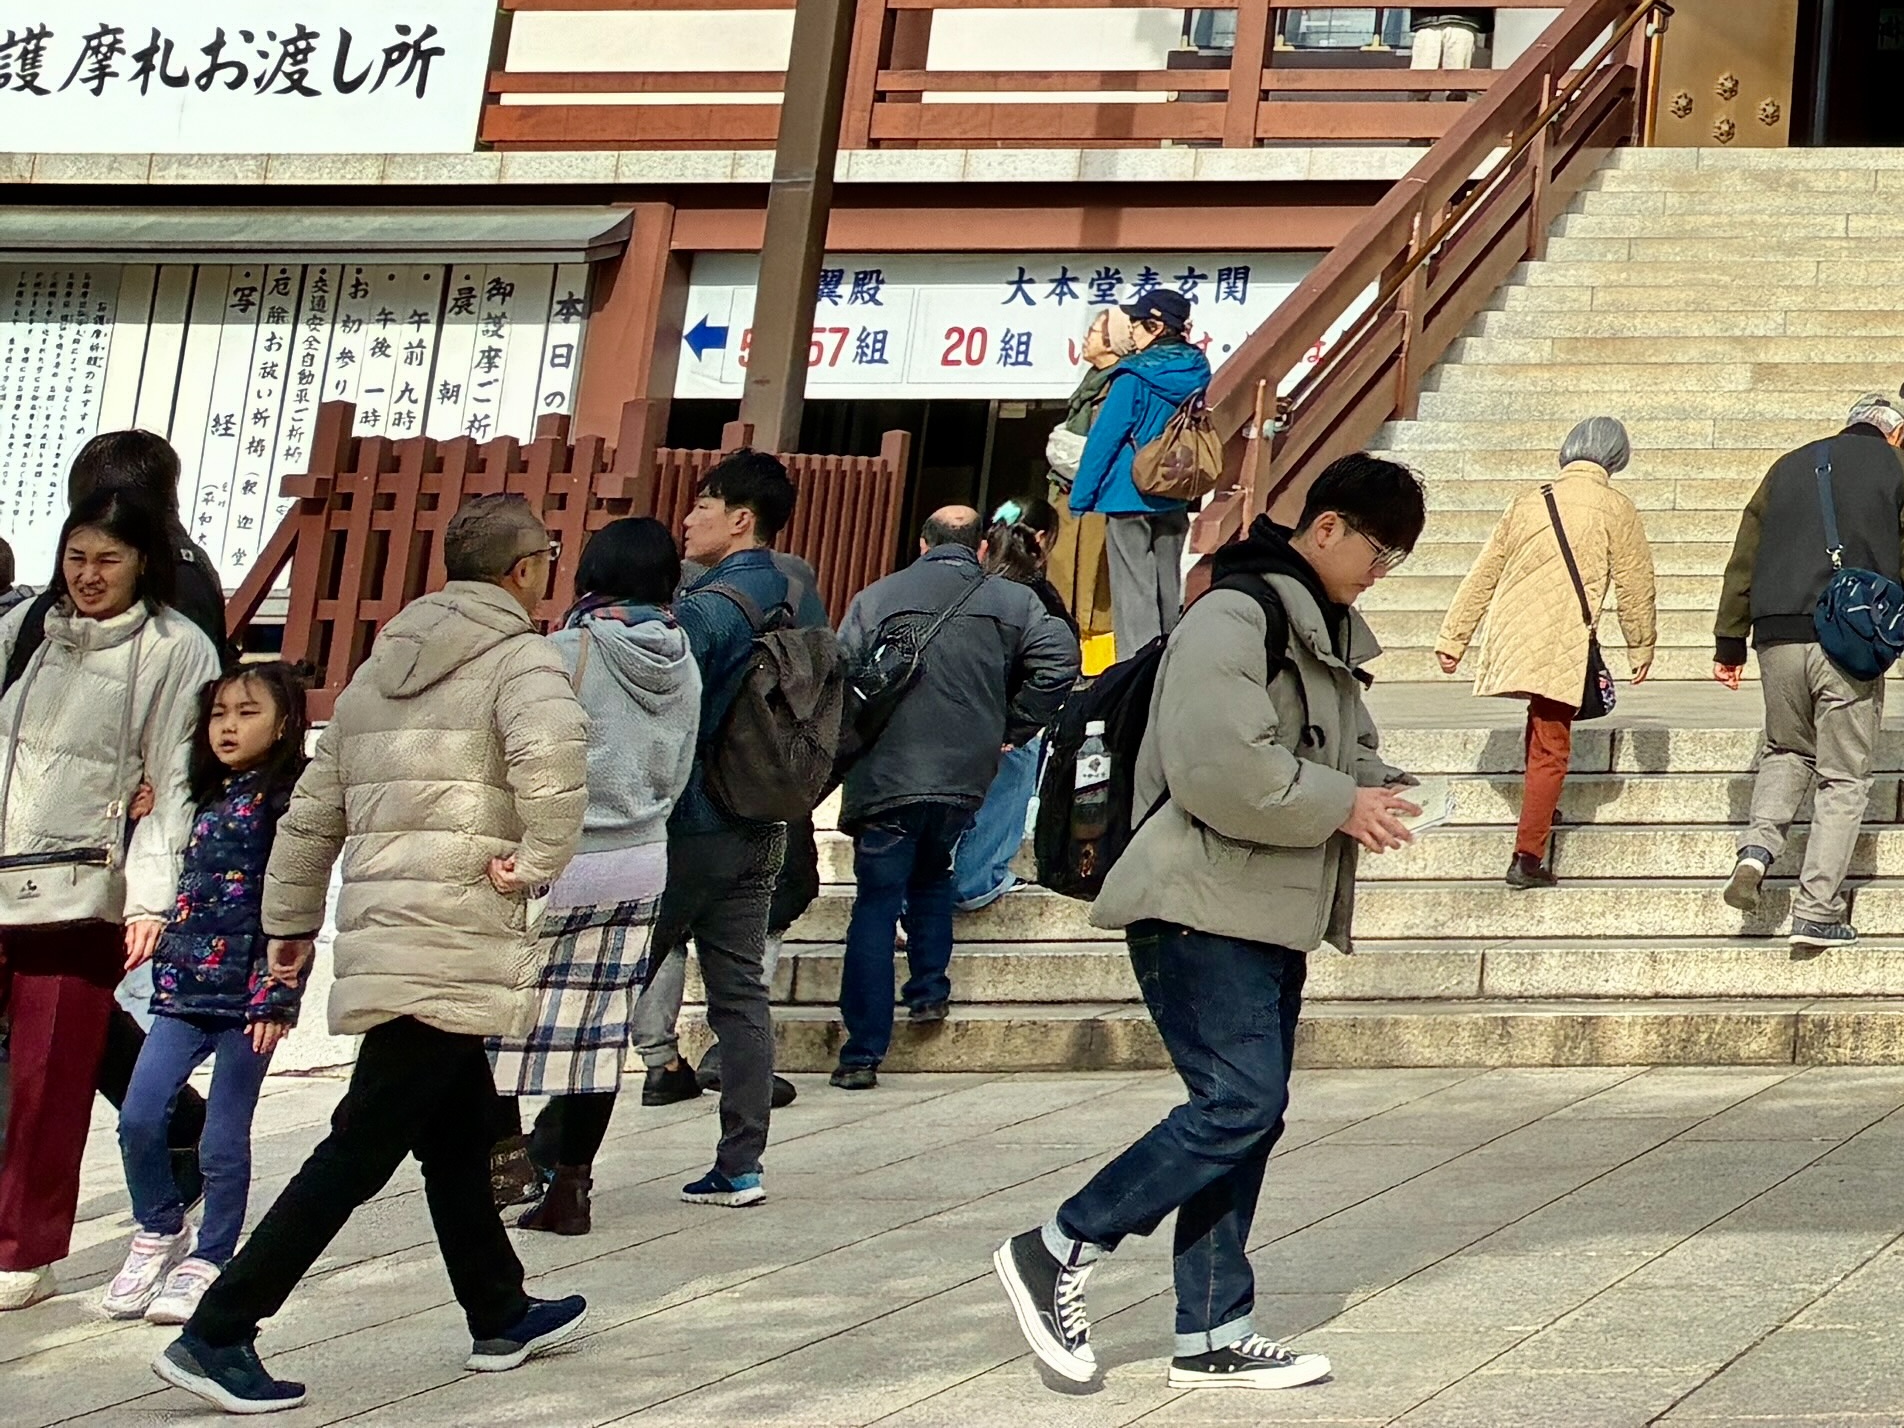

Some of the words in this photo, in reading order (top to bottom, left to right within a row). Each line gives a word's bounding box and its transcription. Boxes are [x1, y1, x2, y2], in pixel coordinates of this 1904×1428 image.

[817, 267, 886, 307] 翼殿
[465, 276, 515, 440] 御護摩ご祈
